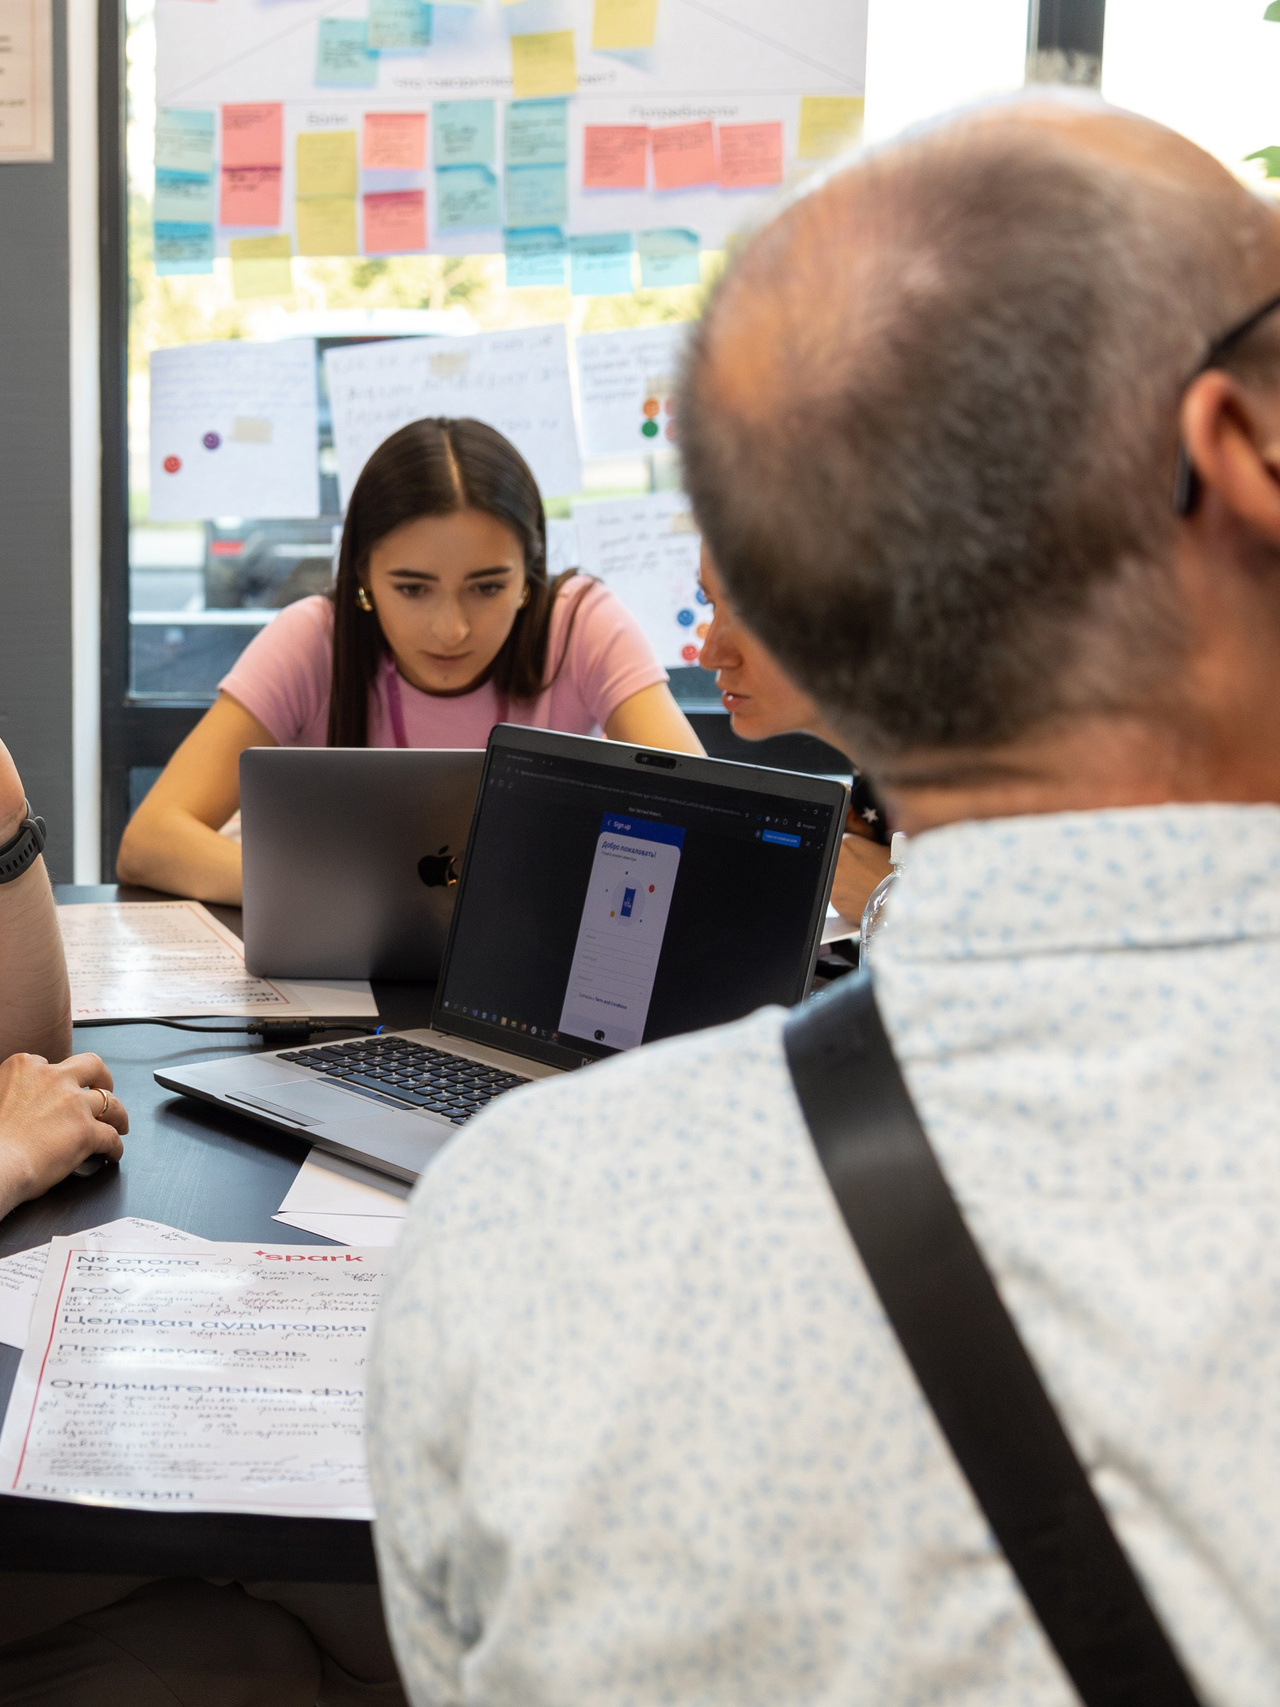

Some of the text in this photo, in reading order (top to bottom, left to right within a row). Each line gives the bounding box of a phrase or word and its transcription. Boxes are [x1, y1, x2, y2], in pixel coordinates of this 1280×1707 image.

[601, 840, 620, 852] Добро
[620, 845, 658, 859] пожаловать!
[116, 1258, 200, 1266] стола
[264, 1254, 364, 1262] spark
[64, 1314, 367, 1333] Целевая аудитория
[233, 1349, 307, 1357] боль
[50, 1379, 303, 1394] Отличительные
